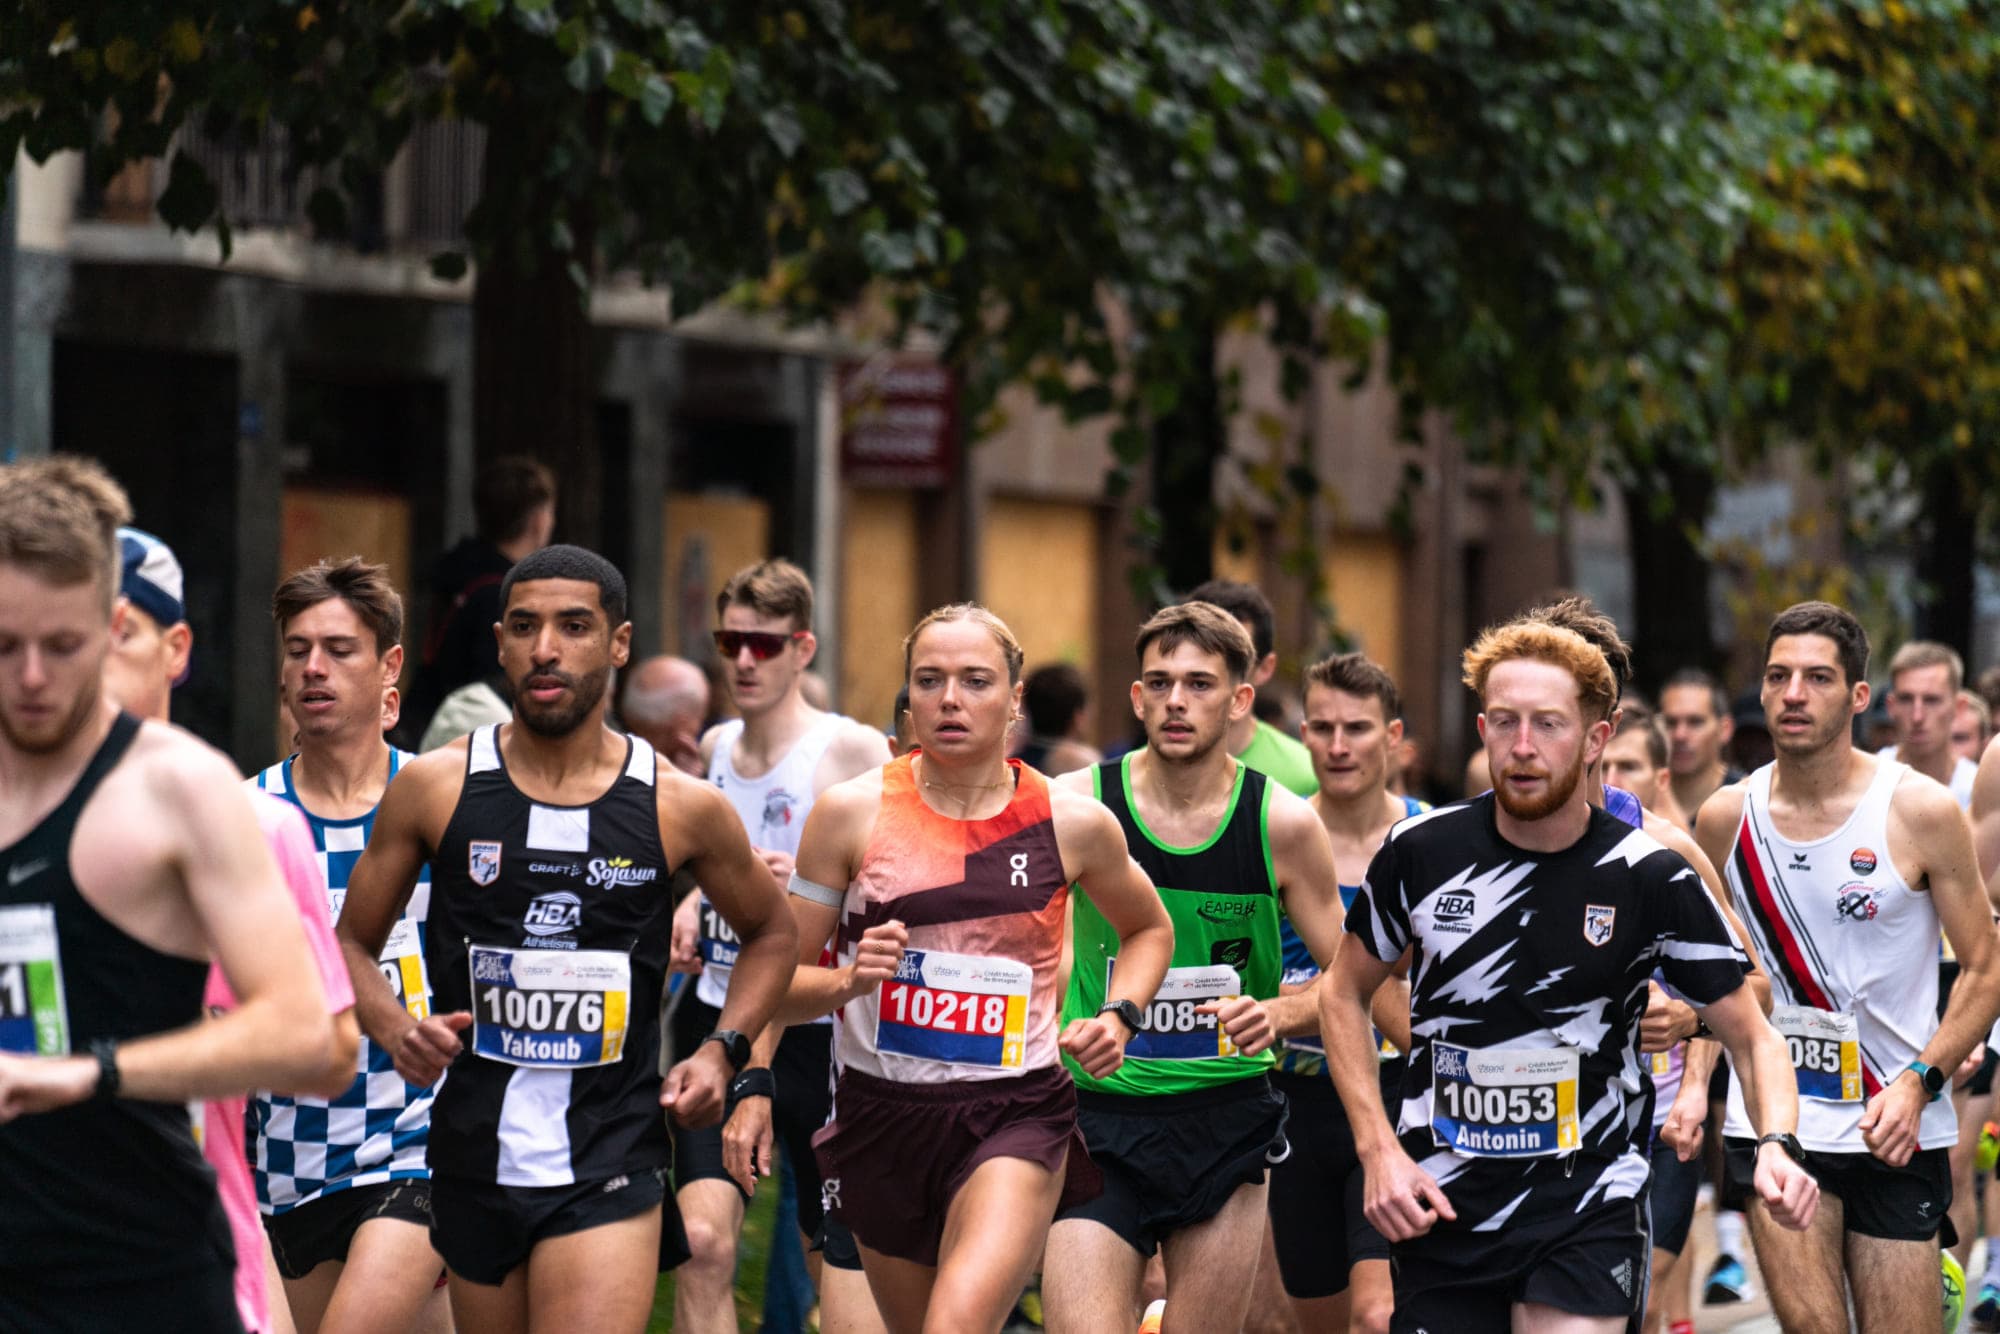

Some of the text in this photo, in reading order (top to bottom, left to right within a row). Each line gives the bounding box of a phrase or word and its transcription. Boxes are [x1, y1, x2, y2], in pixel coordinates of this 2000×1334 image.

[529, 863, 571, 874] CRAFT
[586, 857, 657, 890] Sojasun
[1789, 863, 1811, 871] erima
[524, 902, 581, 926] HBA
[1434, 896, 1475, 916] HBA
[704, 908, 741, 945] 10
[0, 966, 26, 1016] 1
[412, 1004, 422, 1022] 1
[483, 987, 602, 1032] 10076
[890, 985, 1005, 1034] 10218
[501, 1031, 581, 1061] Yakoub
[608, 1040, 616, 1057] 1
[1223, 1035, 1231, 1053] 1
[1008, 1046, 1017, 1064] 1
[1438, 1047, 1461, 1062] TOUT
[1847, 1081, 1856, 1097] 1
[1443, 1082, 1556, 1125] 10053
[1456, 1125, 1541, 1151] Antonin
[1562, 1126, 1571, 1144] 1
